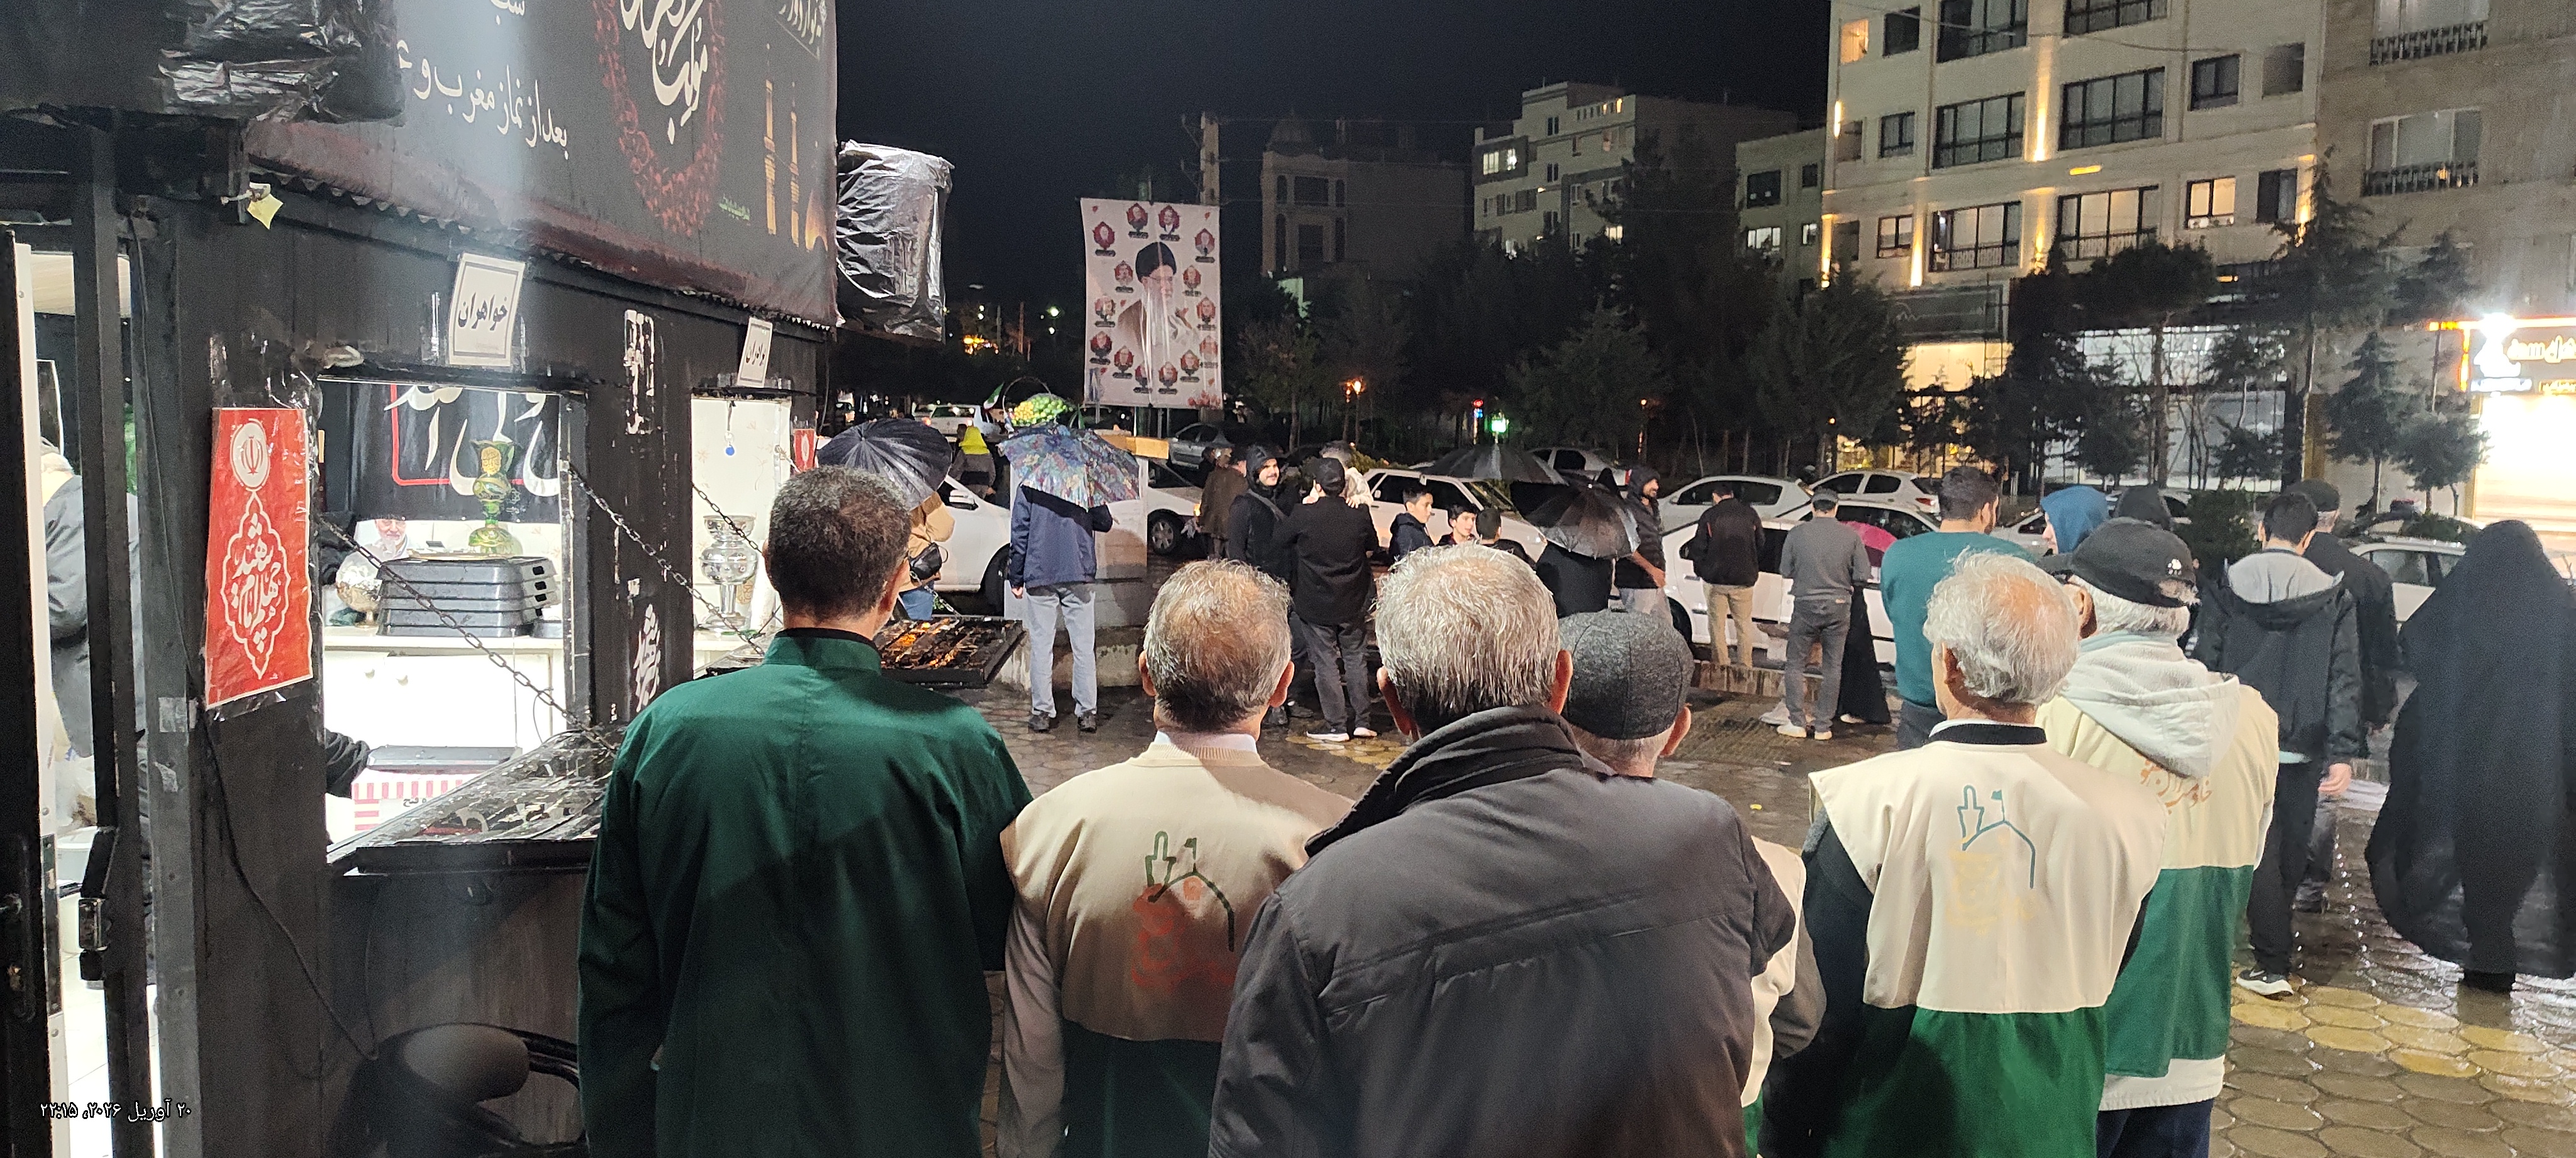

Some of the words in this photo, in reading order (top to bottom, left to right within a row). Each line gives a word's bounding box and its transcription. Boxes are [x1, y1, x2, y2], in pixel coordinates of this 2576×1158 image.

[413, 58, 431, 100] و
[434, 65, 495, 123] مغرب
[497, 64, 523, 135] نماز
[525, 79, 541, 147] از
[542, 108, 569, 160] بعد
[458, 292, 508, 331] خواهران
